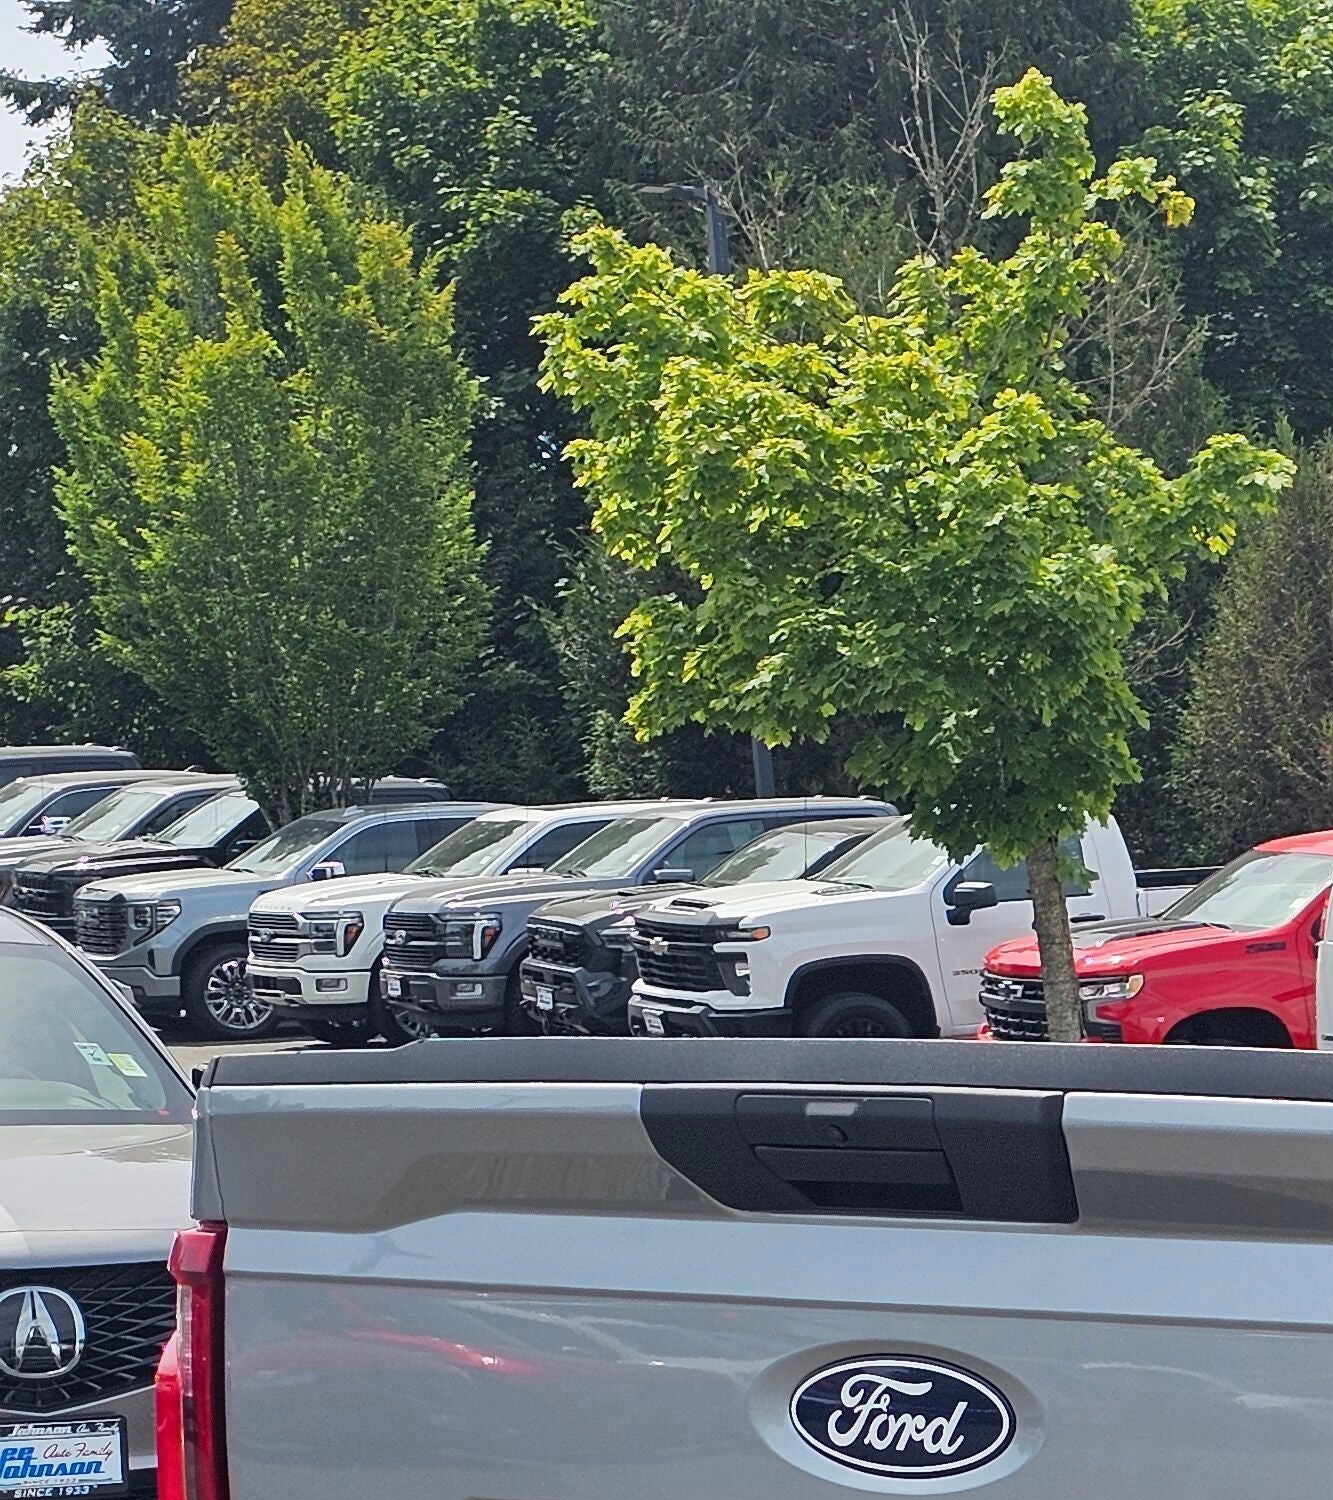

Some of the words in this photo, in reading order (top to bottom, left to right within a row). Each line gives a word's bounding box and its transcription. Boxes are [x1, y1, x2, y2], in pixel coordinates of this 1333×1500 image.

[827, 1373, 969, 1456] Ford
[43, 1443, 72, 1460] Auto
[74, 1441, 114, 1461] Family
[14, 1487, 54, 1499] SINCE
[58, 1485, 90, 1497] 1933
